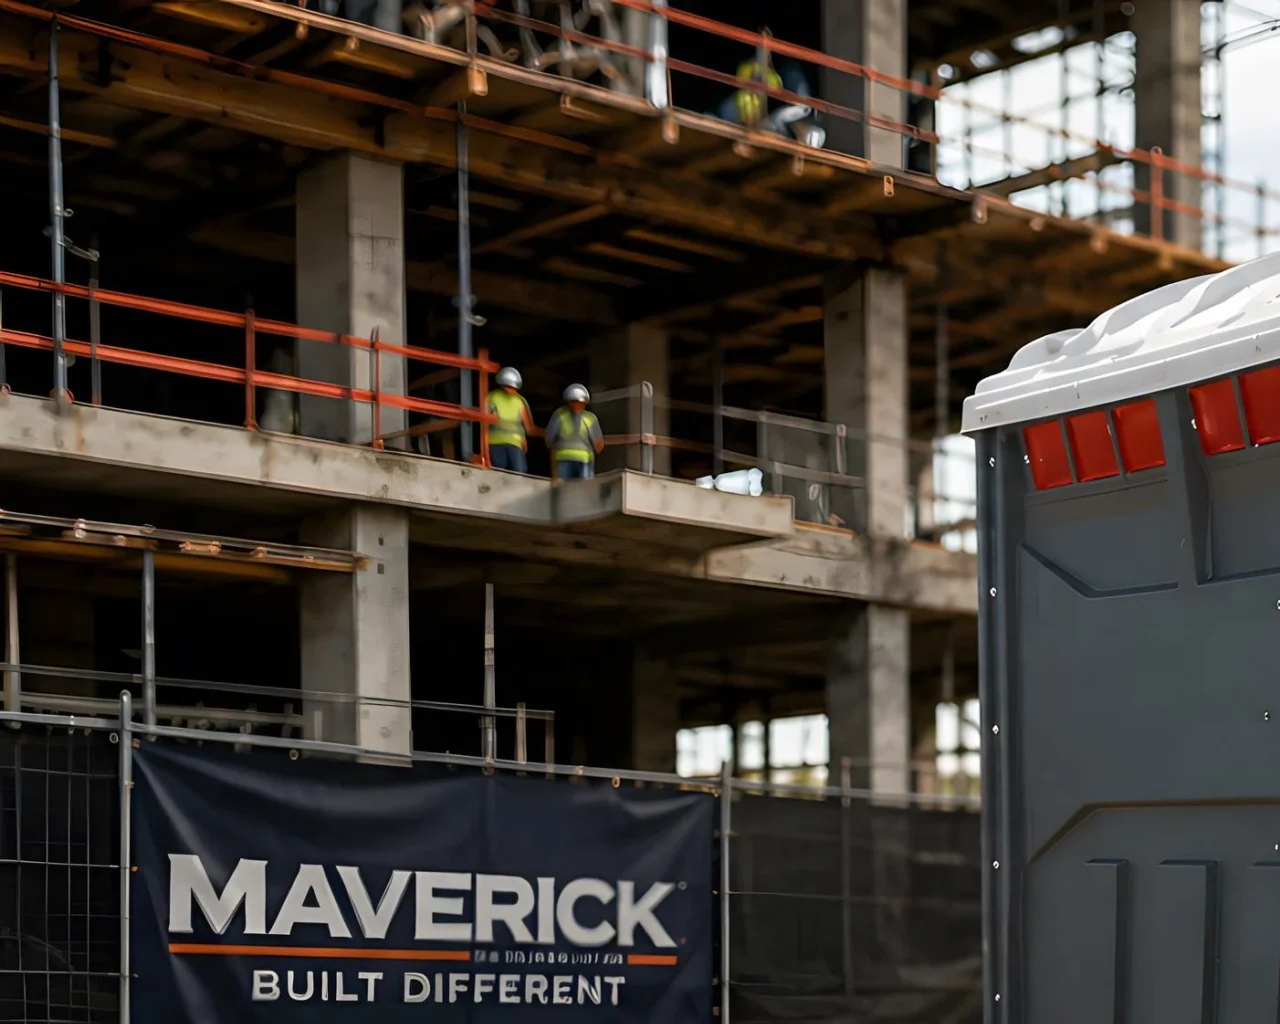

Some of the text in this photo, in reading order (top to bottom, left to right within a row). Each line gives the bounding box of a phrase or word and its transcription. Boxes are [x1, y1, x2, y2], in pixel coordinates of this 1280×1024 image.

[168, 853, 678, 947] MAVERICK
[252, 969, 626, 1006] BUILT DIFFERENT
